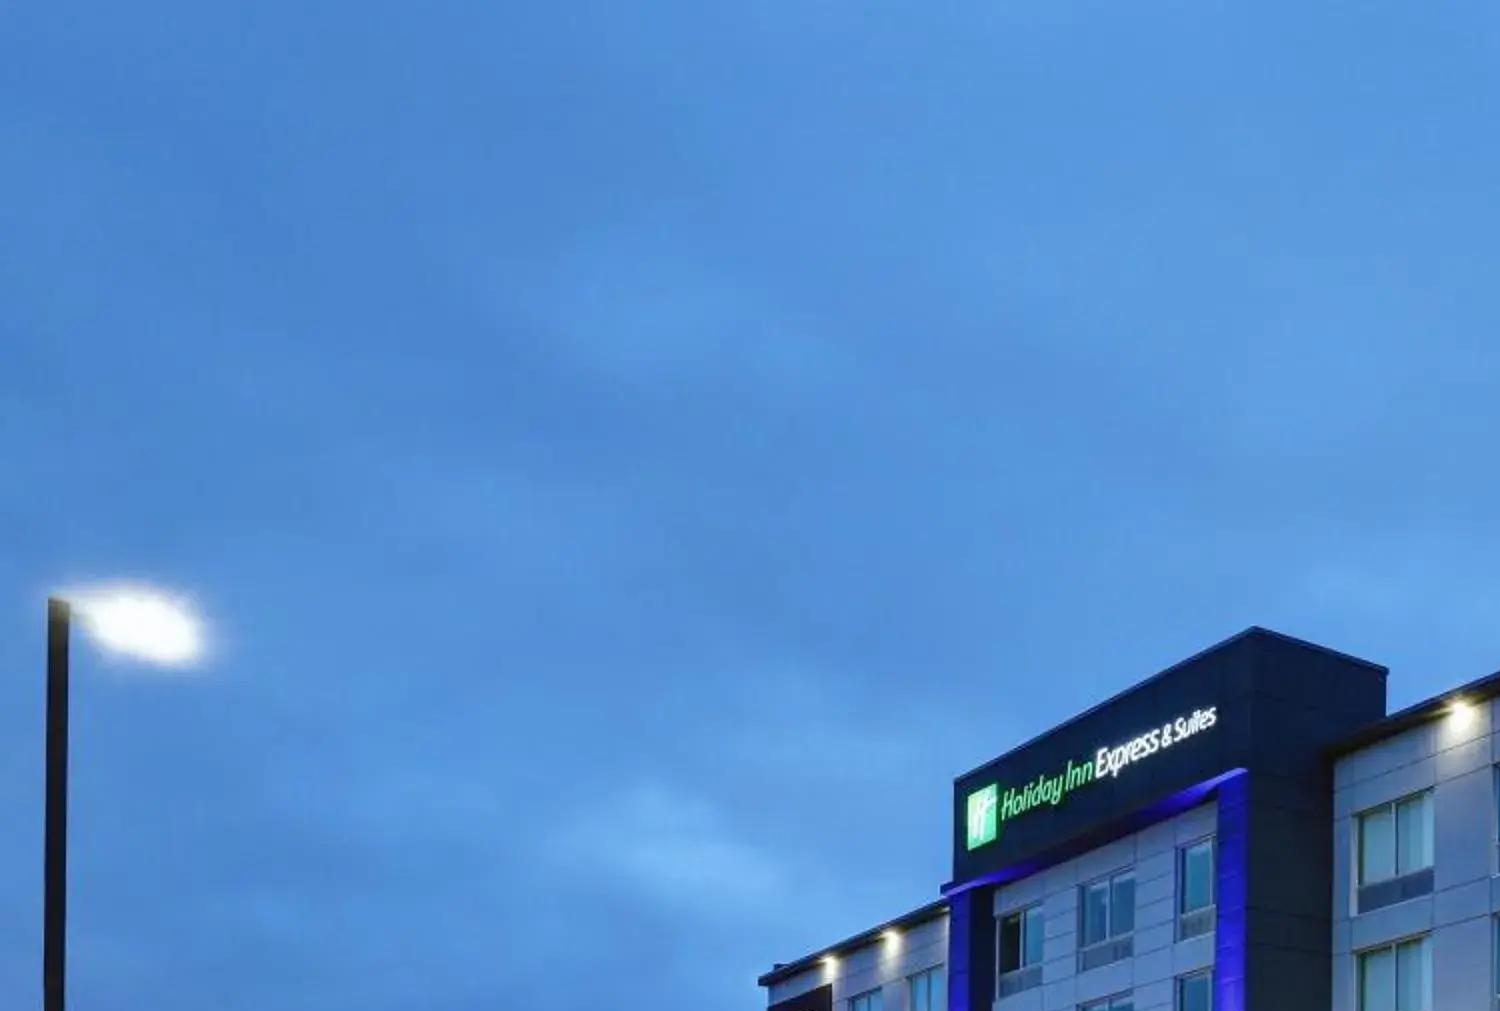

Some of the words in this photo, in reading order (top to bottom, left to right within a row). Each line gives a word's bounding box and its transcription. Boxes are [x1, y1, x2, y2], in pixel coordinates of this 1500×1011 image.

[1001, 771, 1065, 821] Holiday
[1065, 760, 1093, 792] Inn
[1094, 728, 1160, 778] Express
[1161, 723, 1173, 749] &
[1173, 706, 1217, 743] Suites
